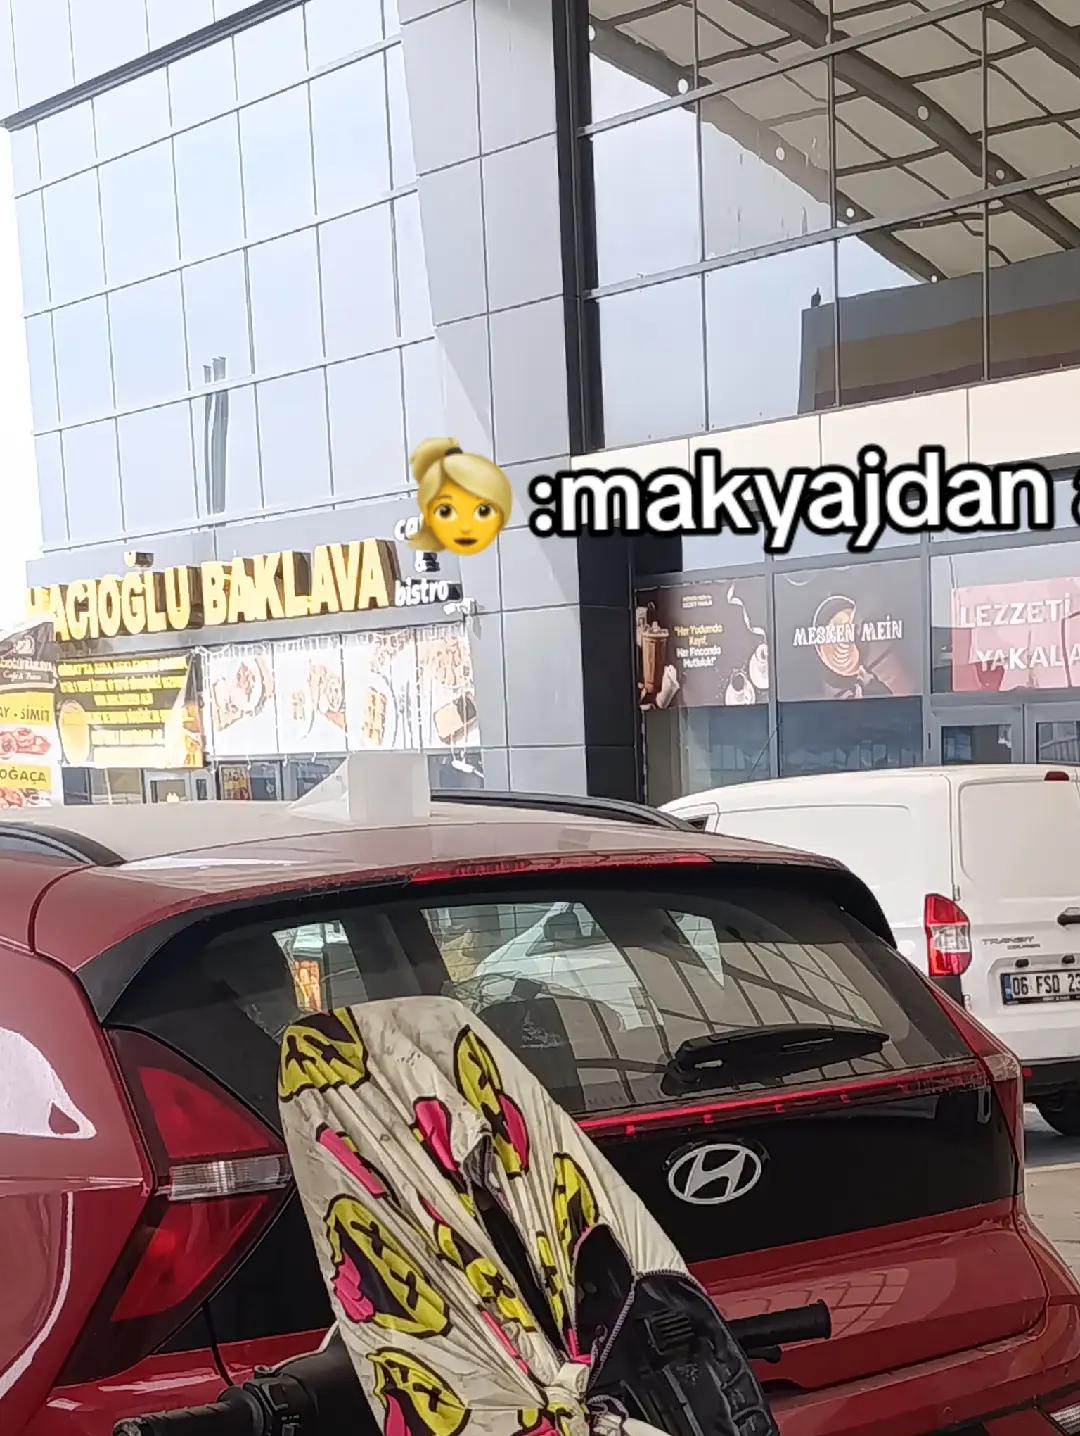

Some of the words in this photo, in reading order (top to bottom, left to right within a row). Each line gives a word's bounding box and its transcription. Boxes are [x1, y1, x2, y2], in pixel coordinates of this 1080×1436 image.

[201, 538, 391, 626] BAKLAVA
[395, 580, 449, 607] bistro
[960, 592, 1072, 627] LEZZETİ
[792, 624, 856, 646] MESKEN
[861, 616, 903, 642] MEİN
[1012, 976, 1029, 996] 06
